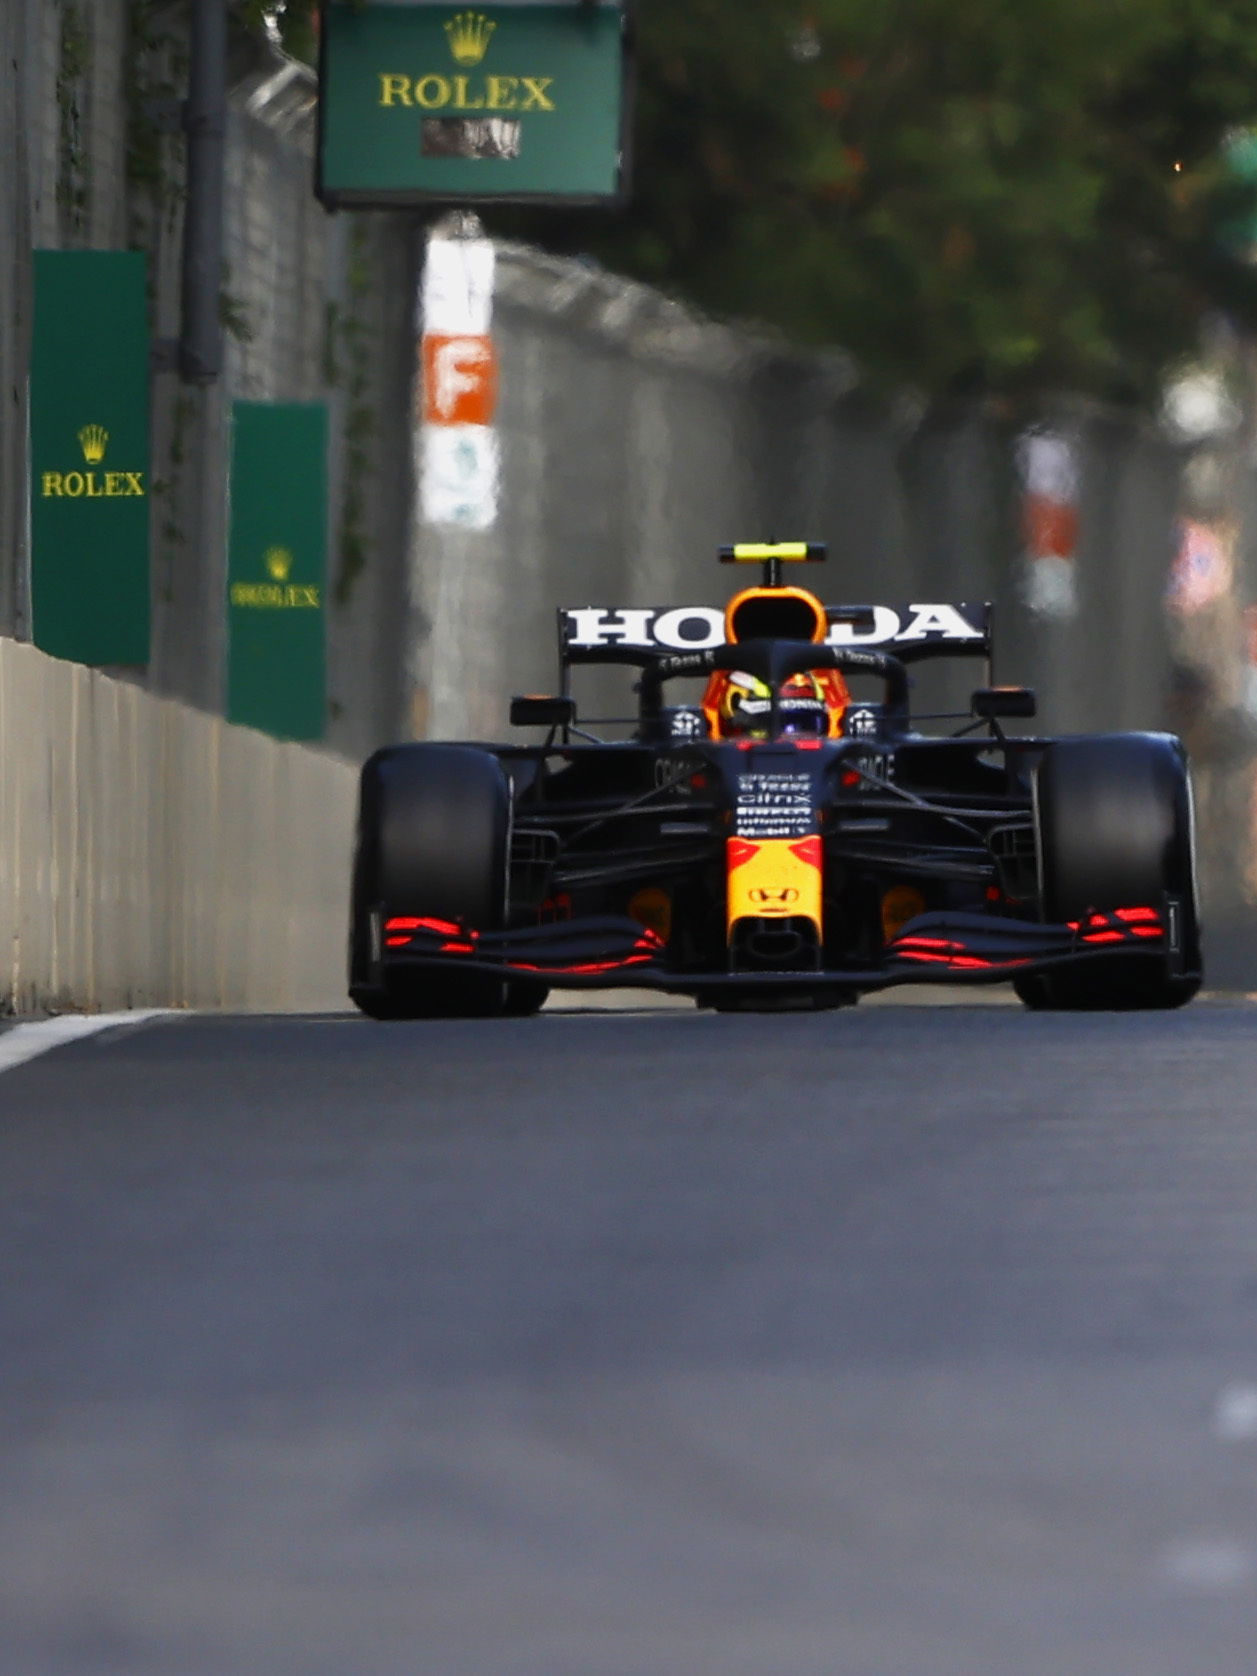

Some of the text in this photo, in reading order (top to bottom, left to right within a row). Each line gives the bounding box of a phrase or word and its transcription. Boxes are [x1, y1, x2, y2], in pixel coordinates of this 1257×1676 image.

[379, 73, 556, 112] ROLEX
[432, 337, 490, 418] F
[42, 471, 145, 498] ROLEX
[567, 604, 984, 649] HODA
